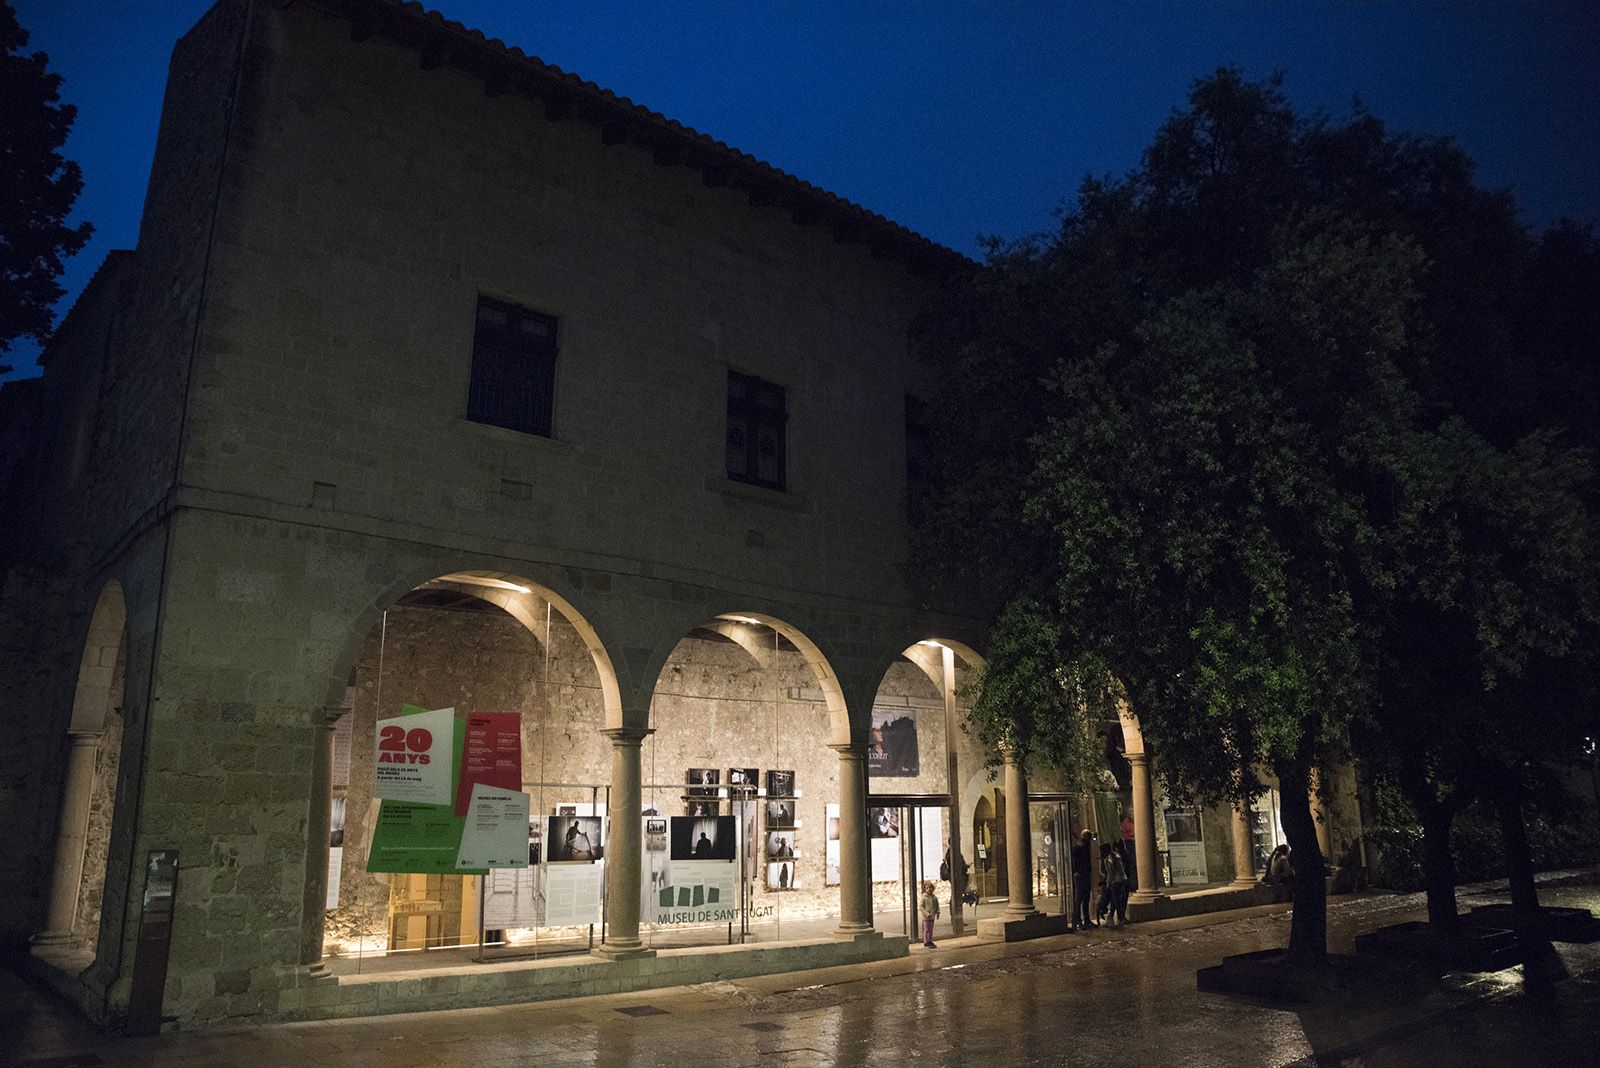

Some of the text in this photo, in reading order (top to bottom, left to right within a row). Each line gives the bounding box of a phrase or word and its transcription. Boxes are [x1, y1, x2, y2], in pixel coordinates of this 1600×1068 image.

[379, 726, 433, 753] 20
[378, 752, 430, 765] ANYS
[657, 911, 696, 925] MUSEU
[698, 910, 711, 922] DE
[714, 908, 740, 921] SANT
